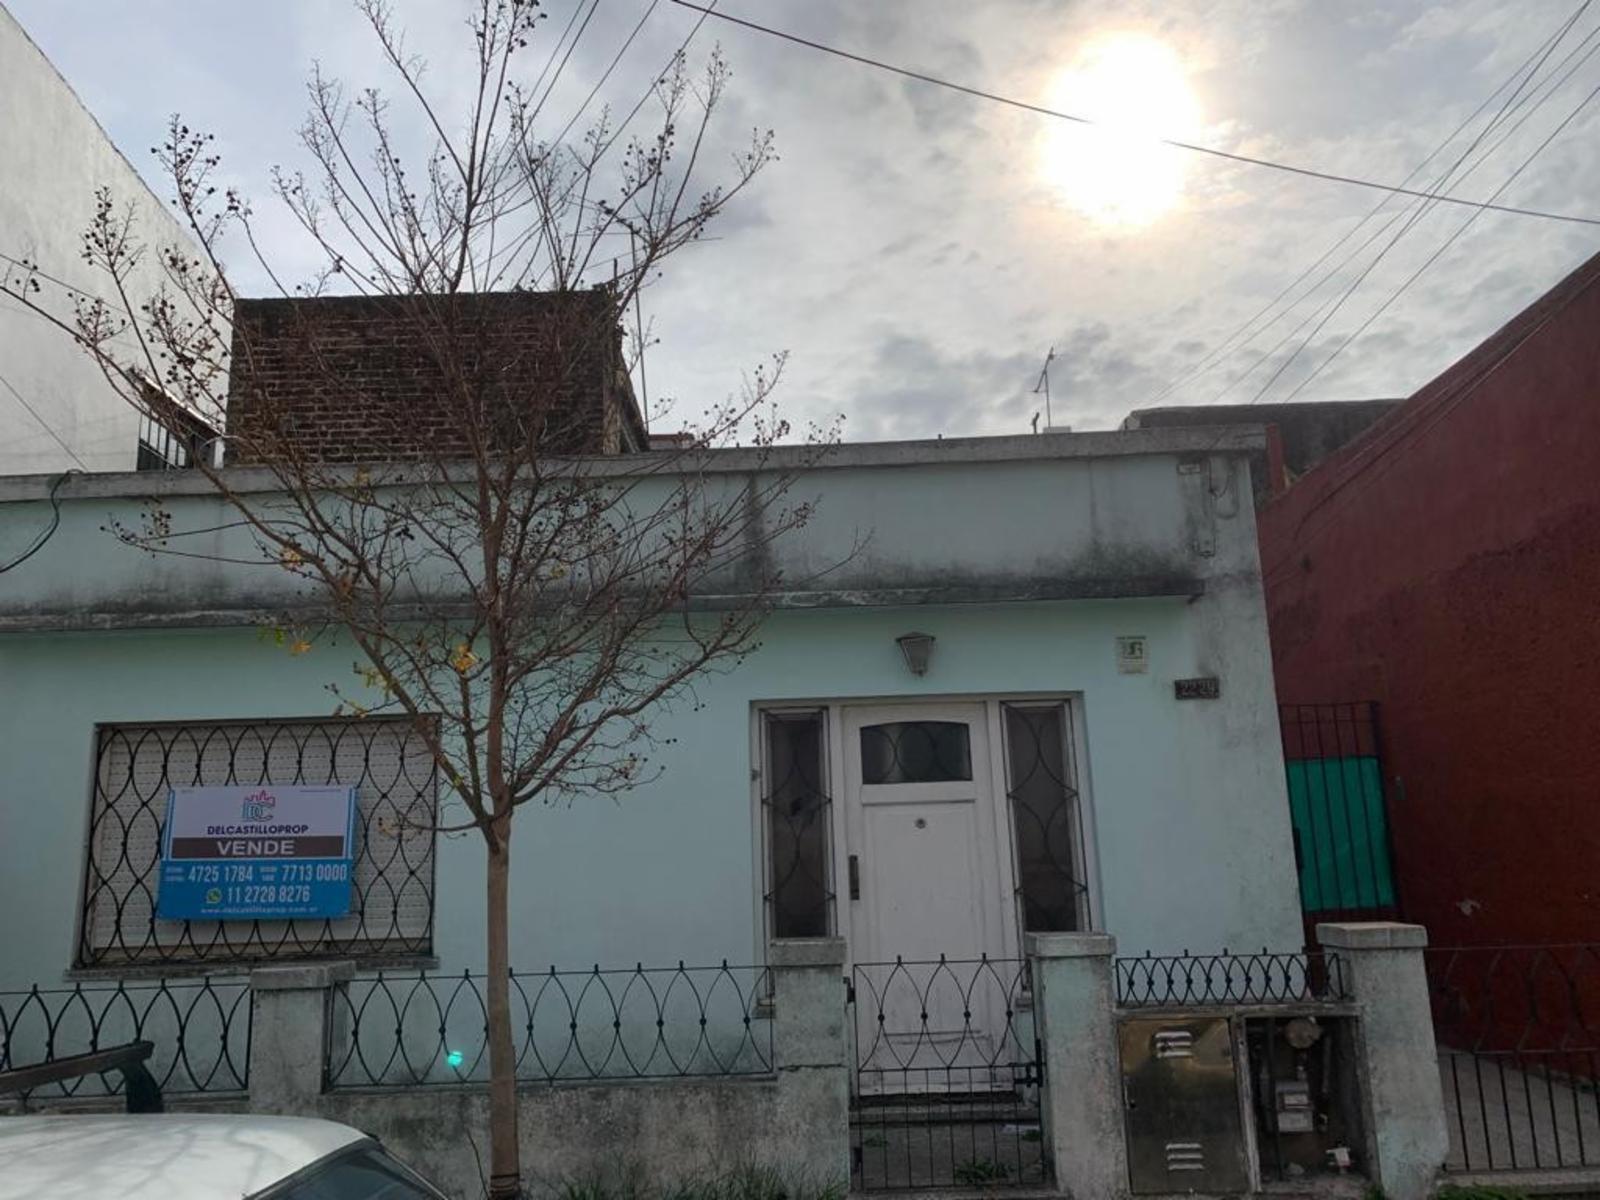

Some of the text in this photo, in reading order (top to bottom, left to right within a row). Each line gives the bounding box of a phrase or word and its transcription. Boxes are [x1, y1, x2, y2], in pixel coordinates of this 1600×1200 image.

[207, 824, 309, 836] DELCASTILLOPROP
[216, 840, 295, 856] VENDE
[188, 866, 219, 882] 4725
[225, 865, 253, 881] 1784
[281, 865, 313, 881] 7713
[316, 864, 347, 881] 0000
[227, 886, 311, 903] 11 2728 8276
